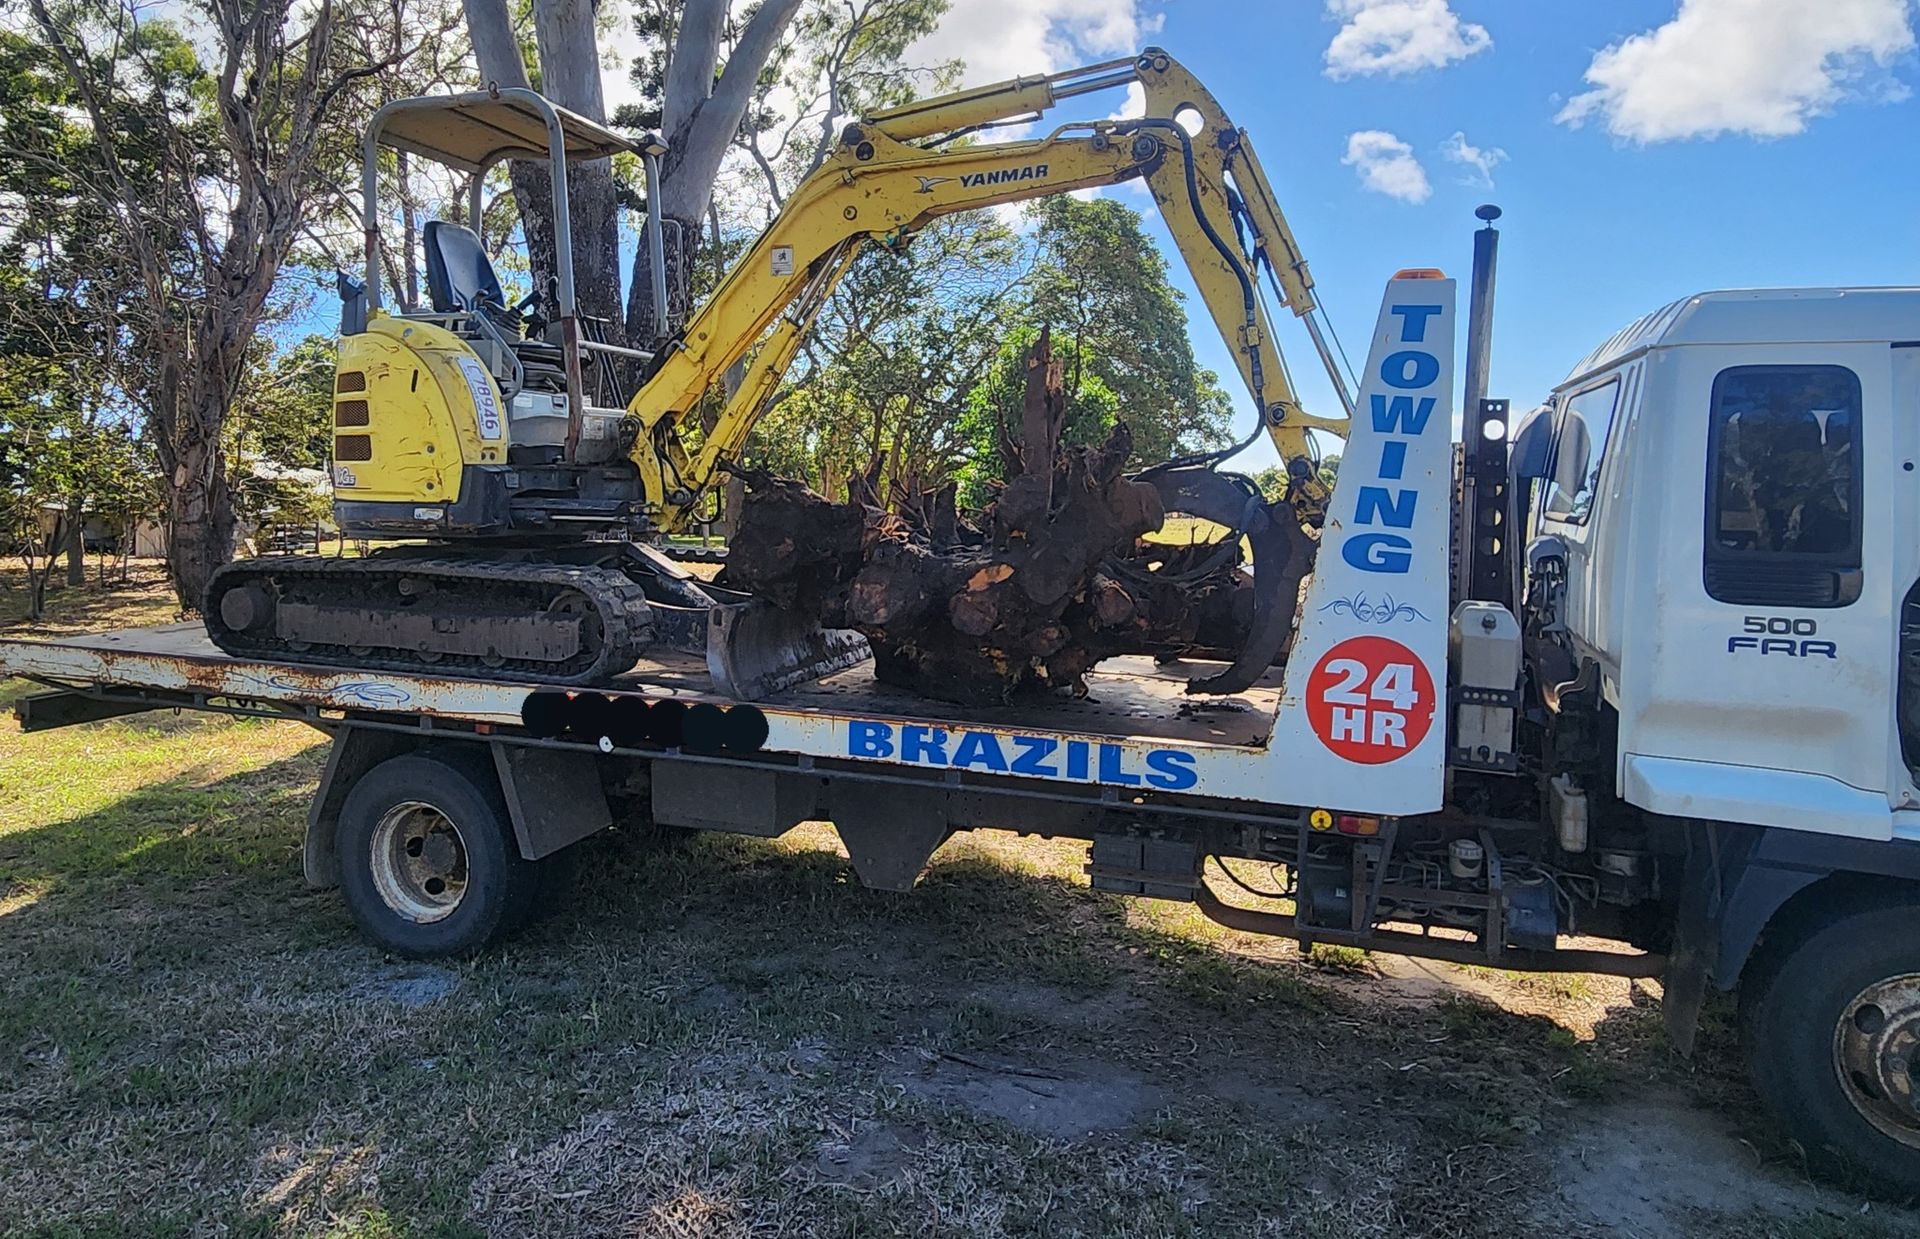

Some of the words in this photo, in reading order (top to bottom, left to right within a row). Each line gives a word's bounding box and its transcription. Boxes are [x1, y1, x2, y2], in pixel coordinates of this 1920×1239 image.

[959, 164, 1049, 188] YANMAR
[1341, 304, 1444, 574] TOWING
[1743, 615, 1817, 636] 500
[1727, 636, 1838, 659] FRR
[1323, 658, 1419, 710] 24
[1331, 706, 1407, 748] HR
[848, 719, 1198, 790] BRAZILS
